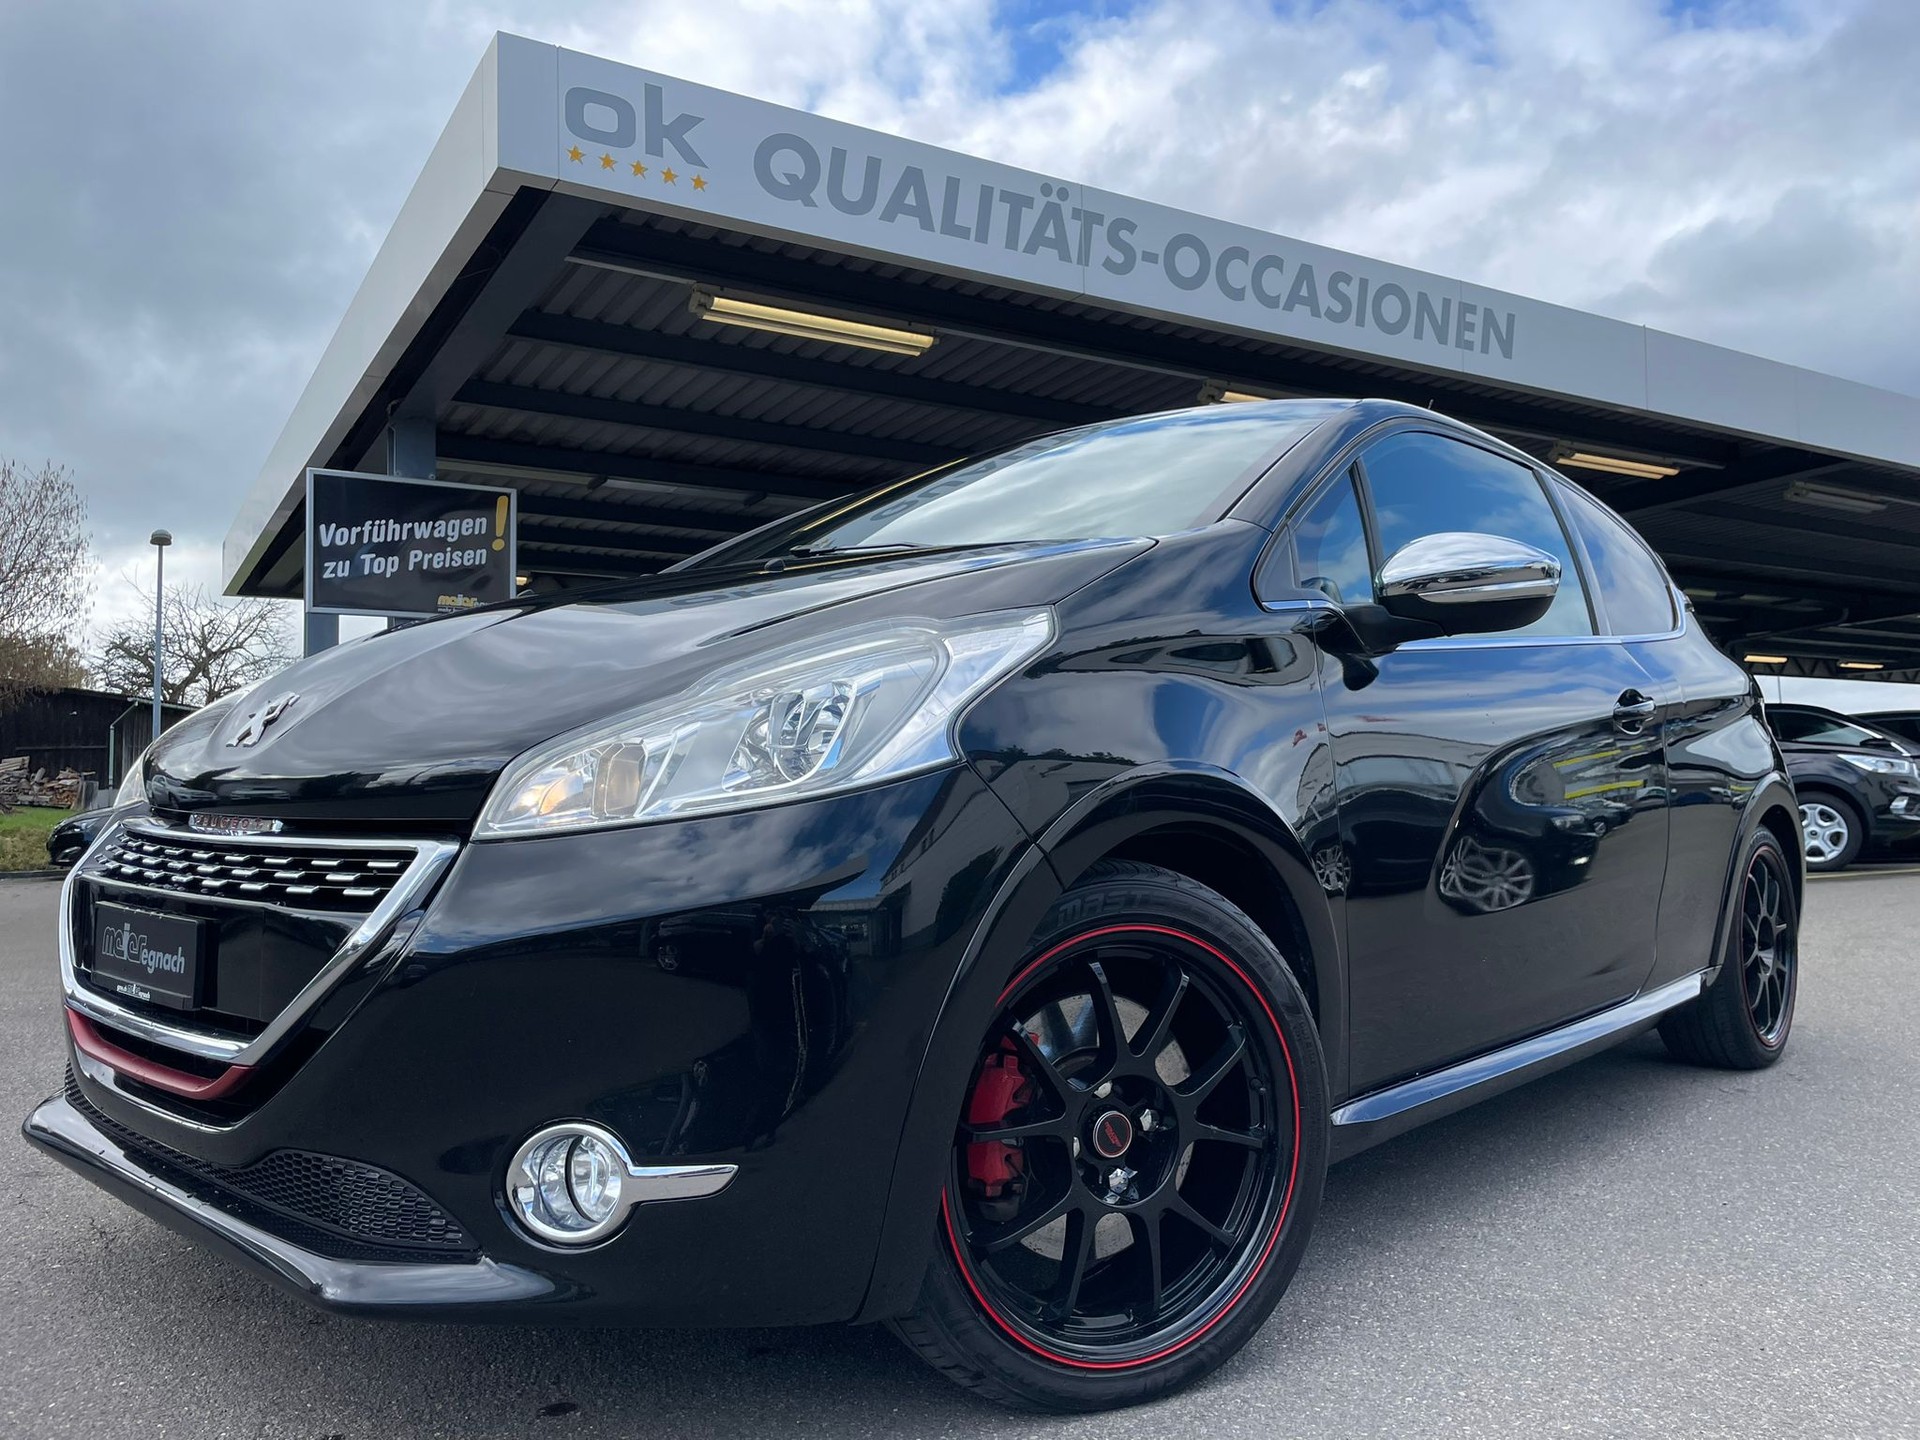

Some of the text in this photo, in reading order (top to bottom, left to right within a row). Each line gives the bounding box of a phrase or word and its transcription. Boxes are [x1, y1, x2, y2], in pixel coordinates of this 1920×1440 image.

[564, 83, 709, 169] ok
[319, 517, 488, 547] Vorführwagen
[322, 547, 487, 579] zu Top Preisen
